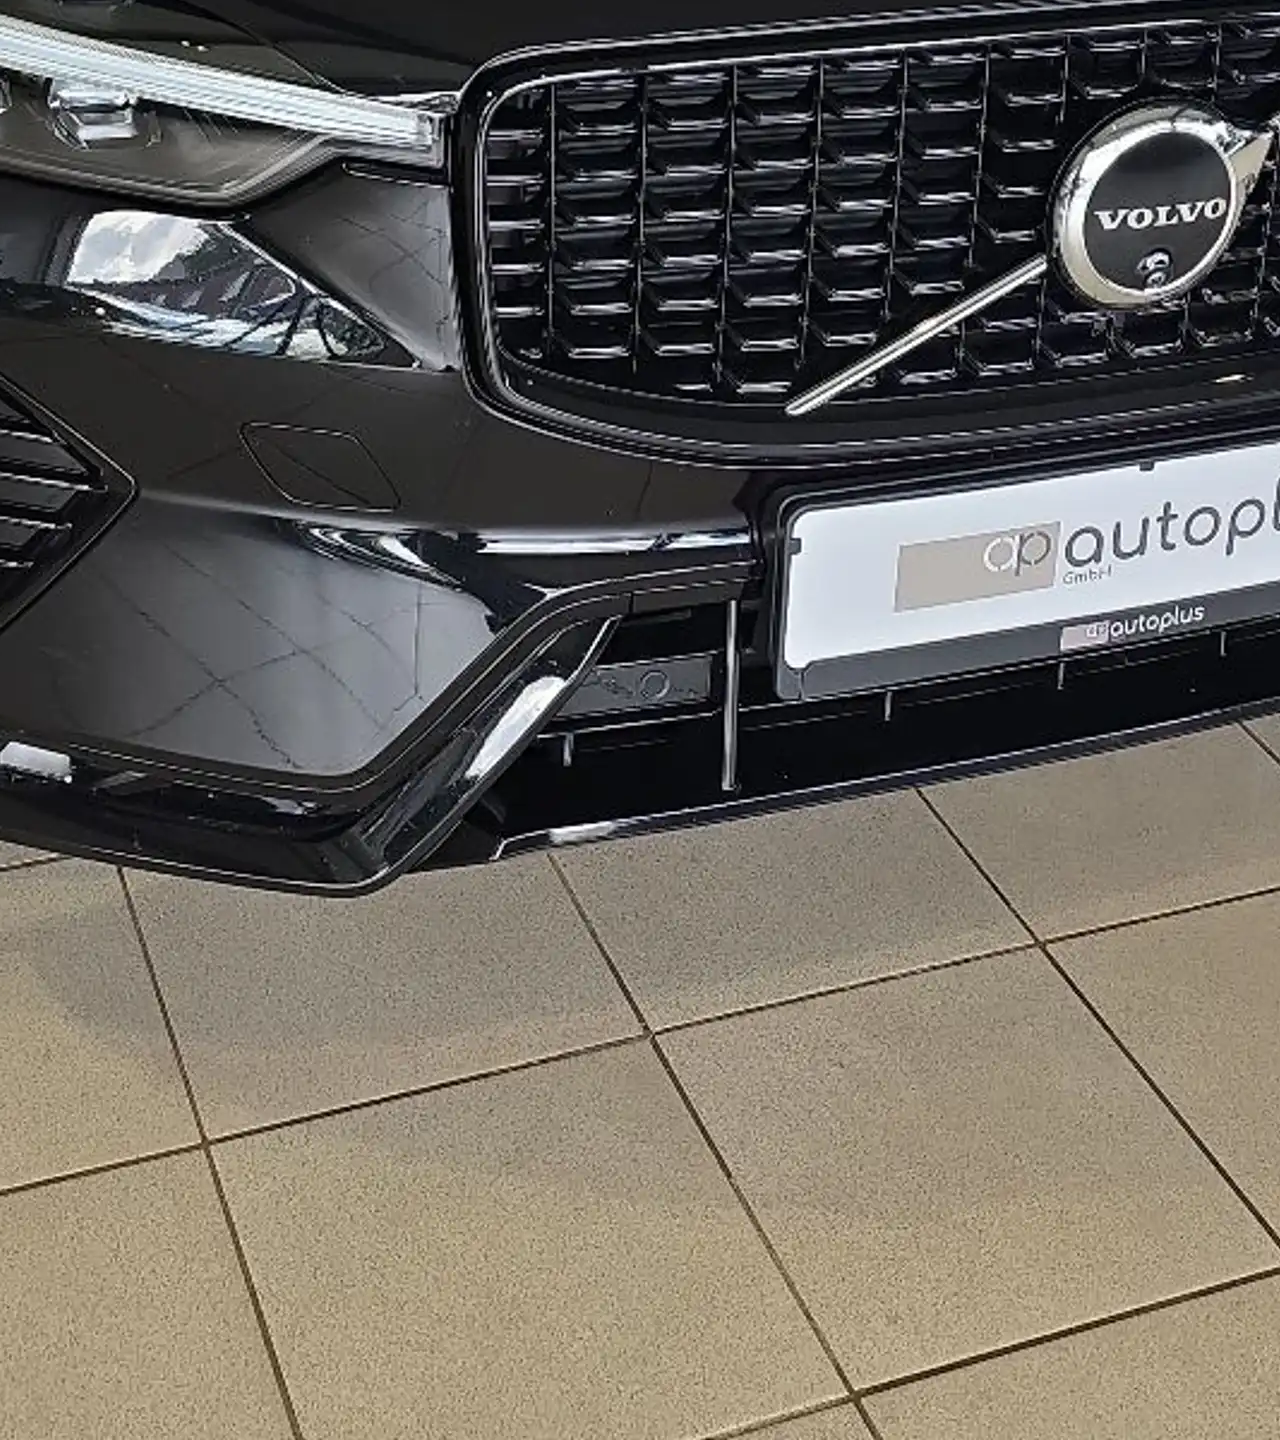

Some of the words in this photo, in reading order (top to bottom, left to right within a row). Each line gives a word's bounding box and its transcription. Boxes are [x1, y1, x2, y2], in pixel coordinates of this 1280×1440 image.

[1094, 197, 1227, 230] VOLVO
[1062, 564, 1112, 585] GmbH
[1110, 605, 1205, 637] autoplus
